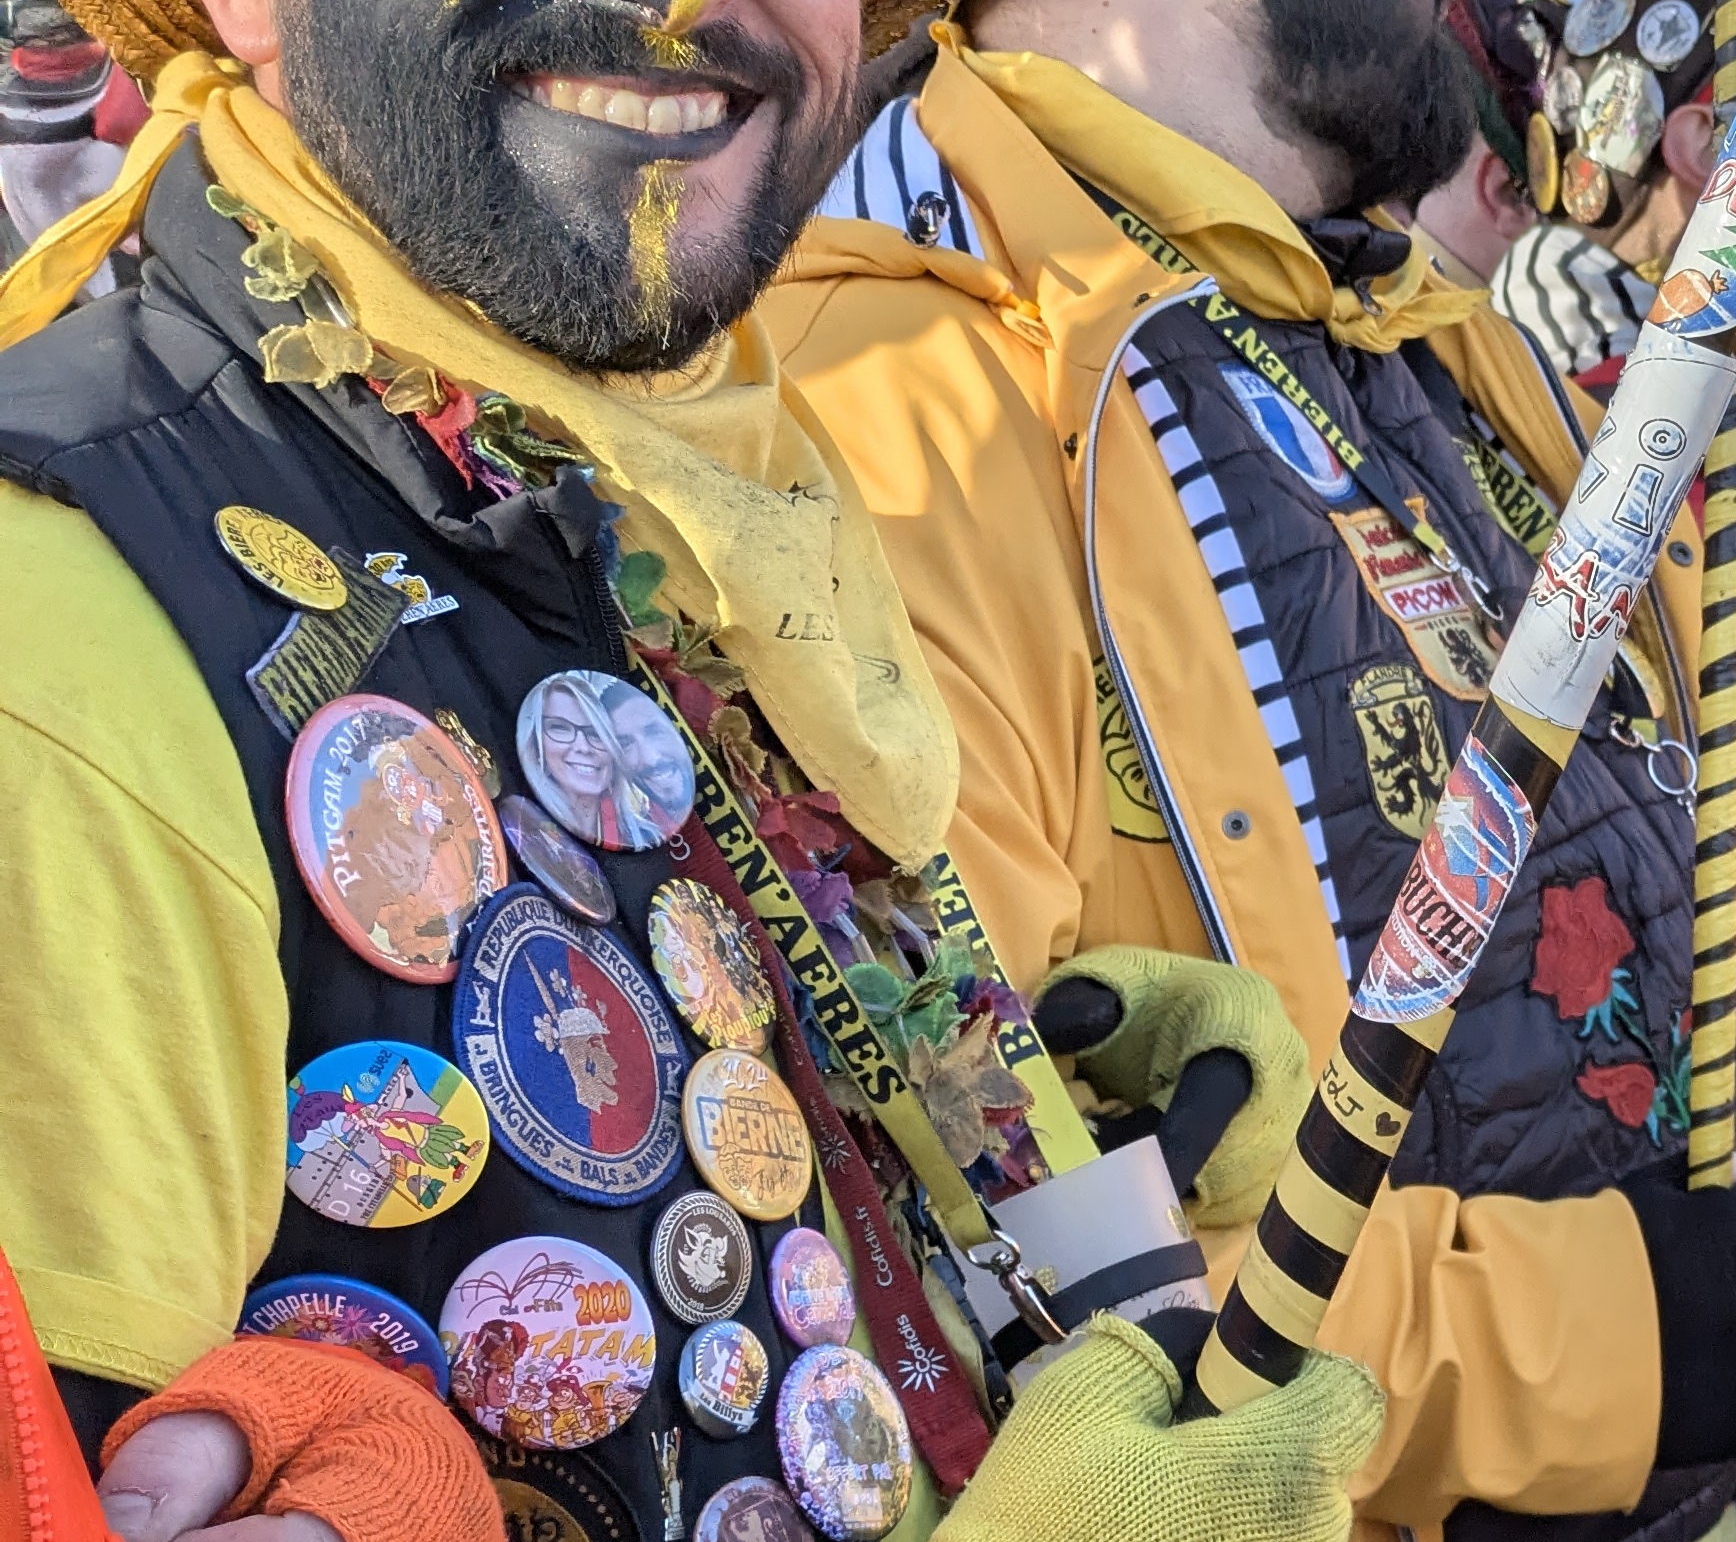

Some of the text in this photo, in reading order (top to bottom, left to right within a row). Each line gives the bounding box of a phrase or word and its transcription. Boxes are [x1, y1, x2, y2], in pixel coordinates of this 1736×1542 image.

[775, 612, 835, 642] LES
[700, 1096, 809, 1161] BIERNE
[579, 1159, 620, 1186] BALS
[855, 1205, 893, 1289] Cofidis.fr
[256, 1291, 346, 1331] CHAPELLE
[369, 1311, 419, 1355] 2019
[573, 1278, 632, 1326] 2020
